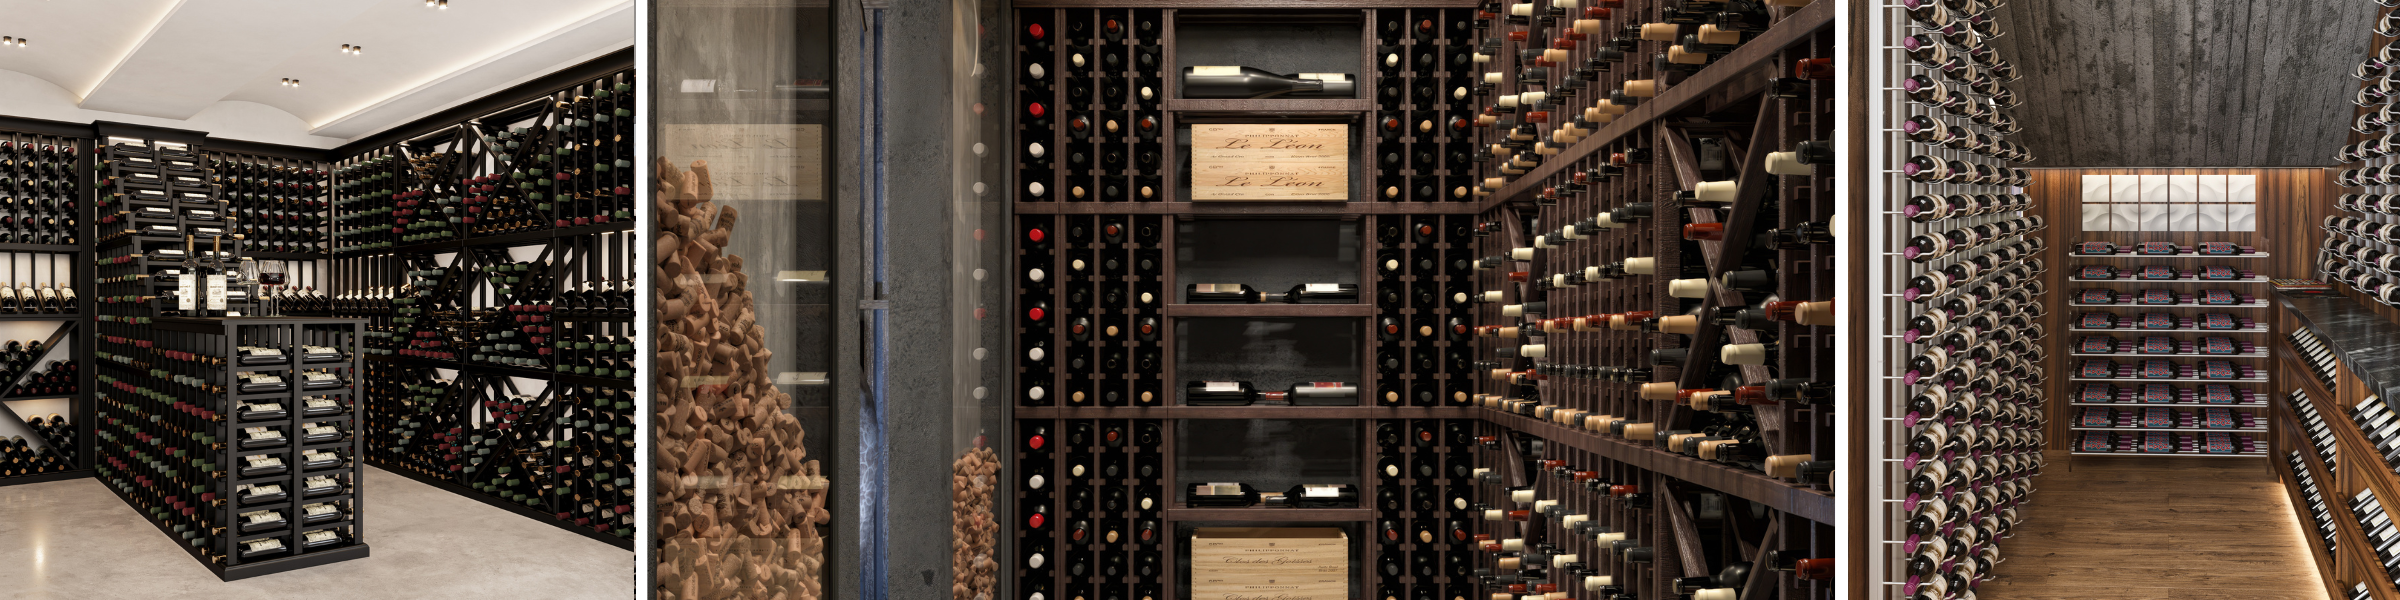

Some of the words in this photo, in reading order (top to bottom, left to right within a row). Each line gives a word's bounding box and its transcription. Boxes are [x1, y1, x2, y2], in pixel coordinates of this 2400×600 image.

[1215, 138, 1251, 149] Le
[1260, 138, 1325, 149] Léon
[1215, 176, 1251, 187] Le
[1260, 176, 1325, 187] Léon
